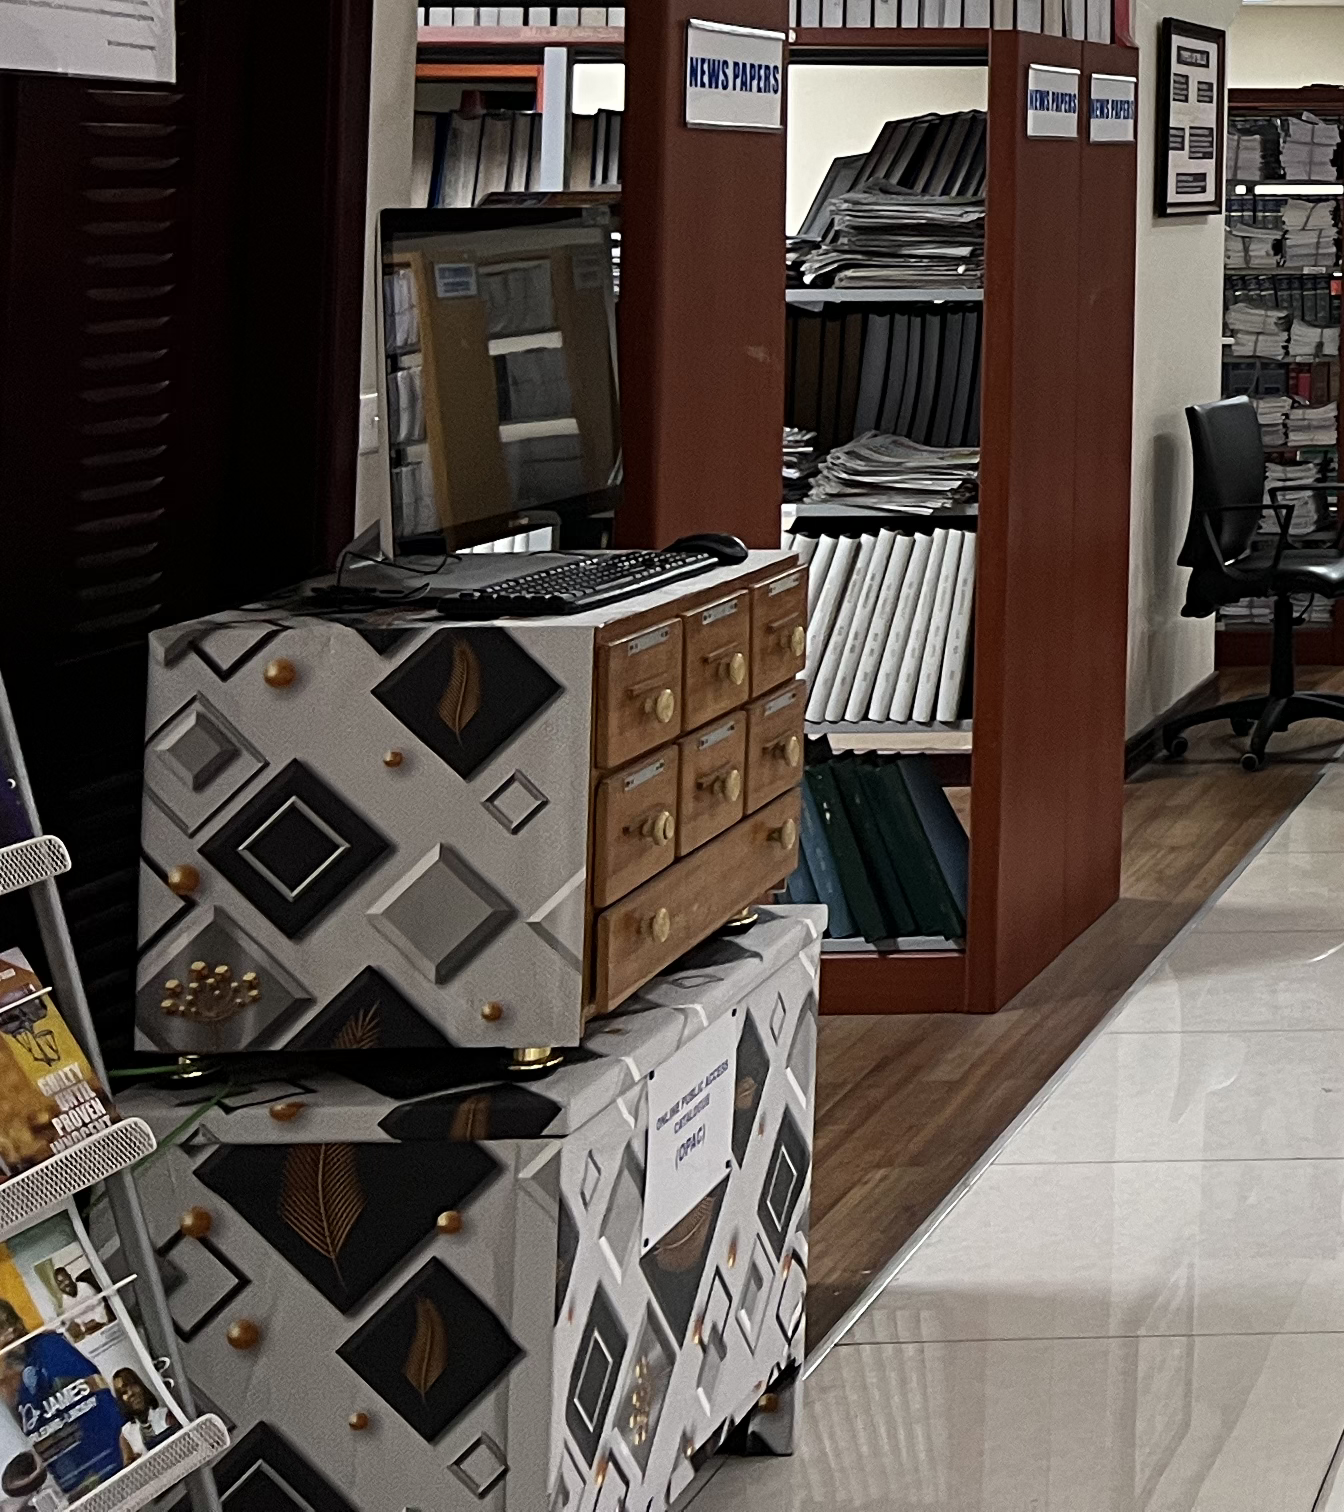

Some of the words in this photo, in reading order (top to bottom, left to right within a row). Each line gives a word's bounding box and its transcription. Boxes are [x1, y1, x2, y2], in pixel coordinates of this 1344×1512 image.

[689, 56, 729, 91] NEWS
[732, 60, 779, 95] PAPERS
[1029, 89, 1050, 112] NEWS
[1051, 91, 1077, 114] PAPERS
[51, 1097, 107, 1136] PROVEN
[43, 1378, 91, 1419] JAMES
